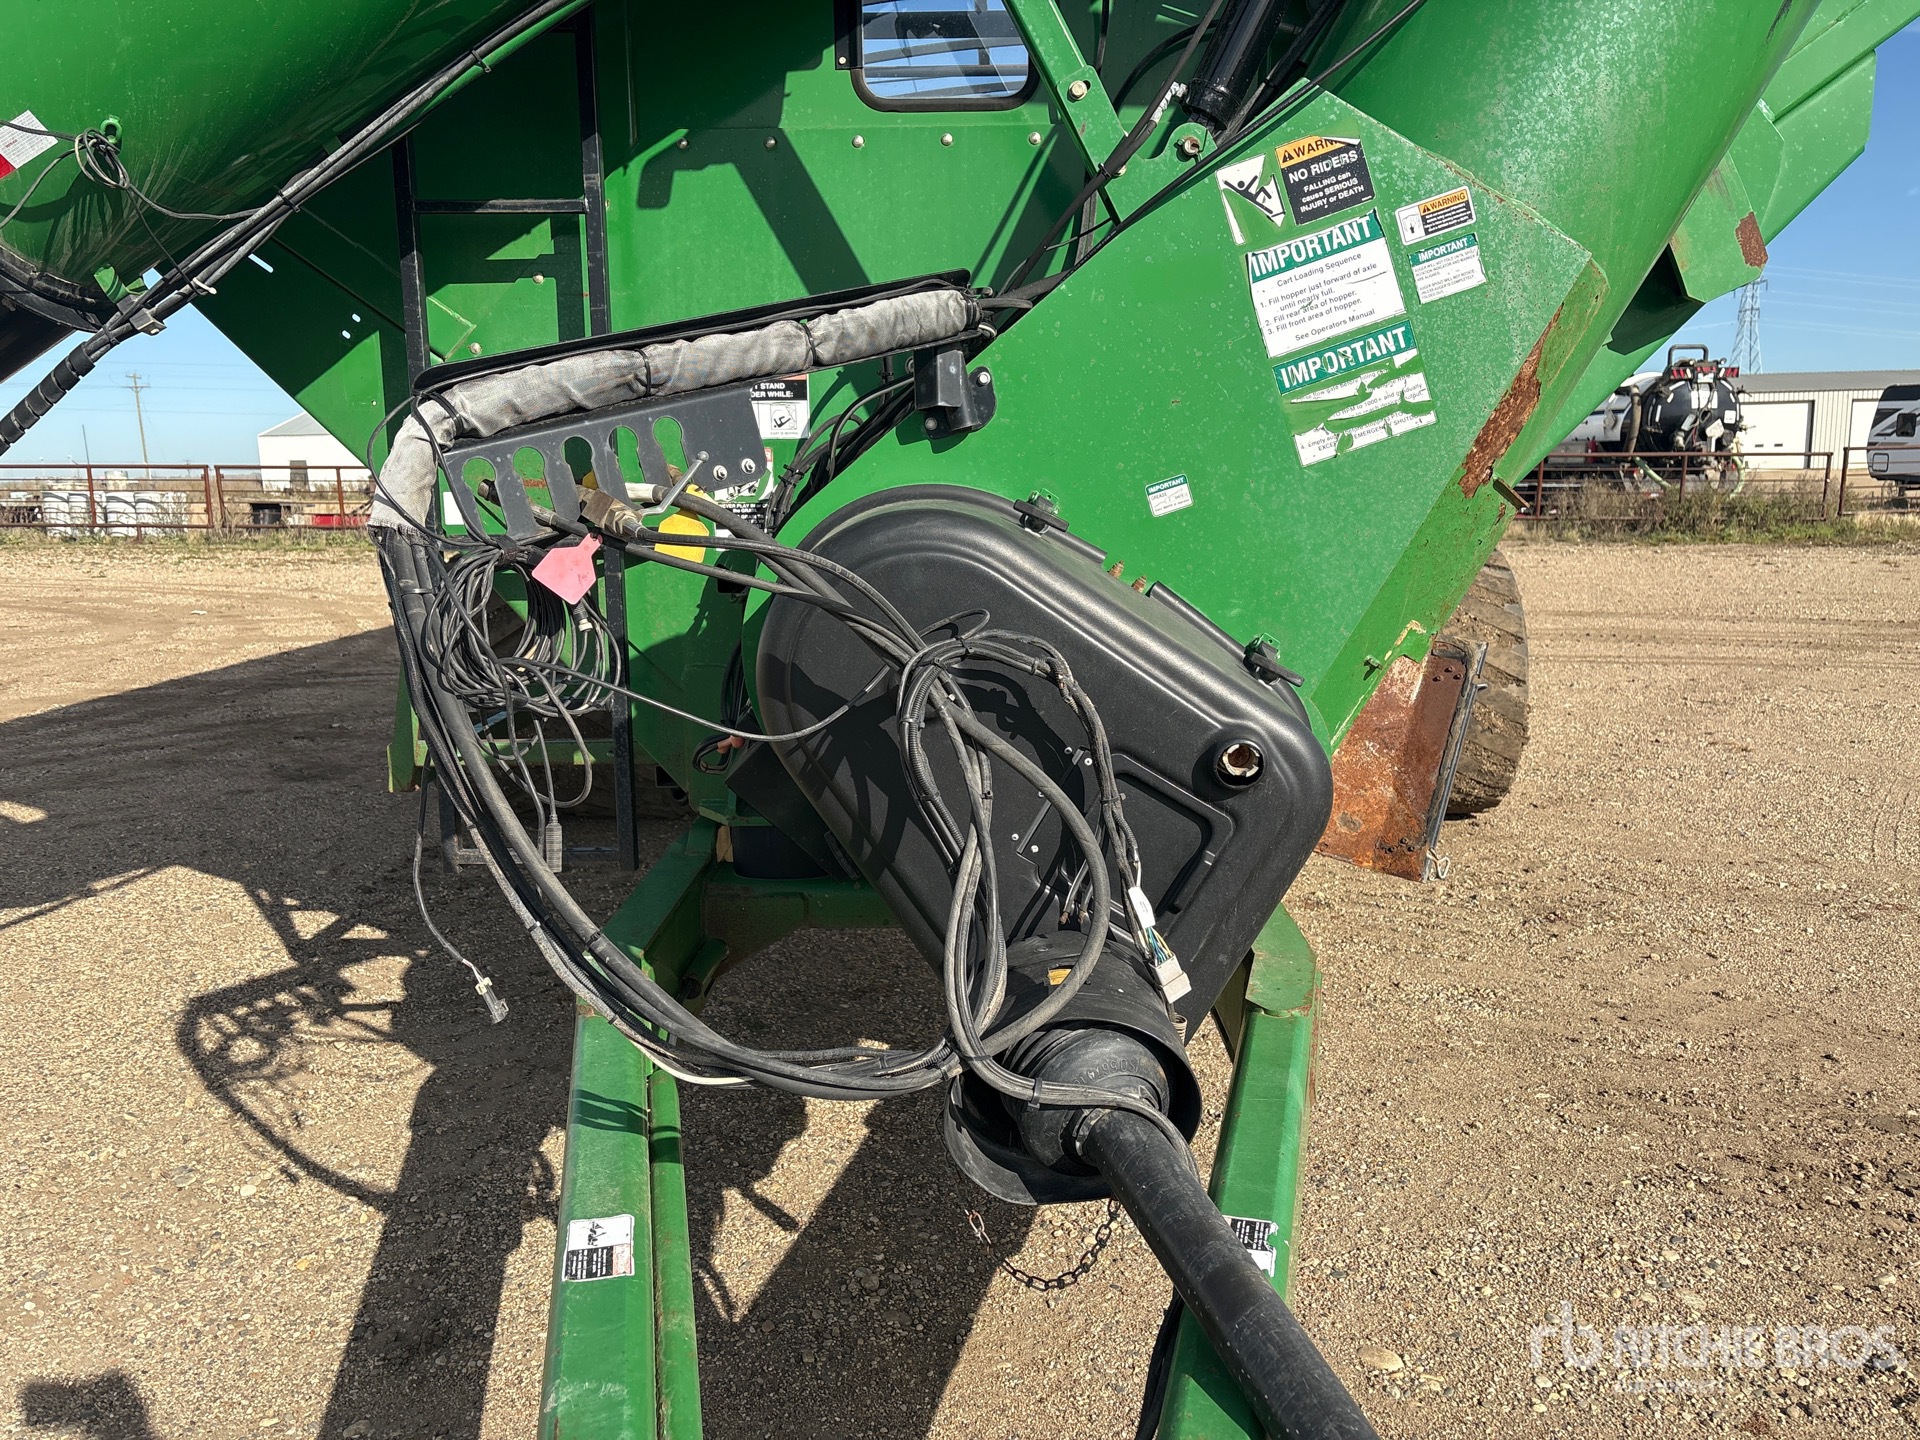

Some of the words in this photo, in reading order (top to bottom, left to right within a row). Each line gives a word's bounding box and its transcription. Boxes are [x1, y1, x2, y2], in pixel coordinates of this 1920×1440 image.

[1293, 139, 1338, 158] WARN
[1288, 168, 1308, 183] NO
[1310, 150, 1358, 176] RIDERS
[1301, 191, 1324, 203] cause
[1324, 177, 1358, 195] SERIOUS
[1303, 176, 1336, 193] FALLING
[1337, 172, 1351, 181] can
[1300, 197, 1327, 213] INJURY
[1328, 195, 1337, 203] or
[1337, 185, 1365, 200] DEATH
[1430, 192, 1466, 211] WARNING
[1251, 216, 1371, 277] IMPORTANT
[1418, 238, 1468, 262] IMPORTANT
[1268, 297, 1280, 306] Fill
[1281, 288, 1307, 304] hopper
[1308, 282, 1322, 293] just
[1323, 273, 1351, 288] forward
[1353, 267, 1362, 277] of
[1362, 262, 1377, 273] axle
[1277, 276, 1293, 287] Cart
[1294, 266, 1324, 280] Loading
[1325, 253, 1362, 270] Sequence
[1273, 314, 1285, 323] Fill
[1286, 309, 1301, 318] rear
[1302, 305, 1319, 313] area
[1320, 298, 1329, 307] of
[1329, 290, 1357, 305] hopper.
[1280, 301, 1296, 311] until
[1297, 294, 1320, 308] nearly
[1321, 287, 1336, 297] full.
[1276, 322, 1287, 332] Fill
[1288, 317, 1306, 329] front
[1307, 312, 1324, 322] area
[1325, 306, 1333, 315] of
[1333, 298, 1362, 314] hopper.
[1295, 332, 1309, 341] See
[1311, 319, 1347, 337] Operators
[1349, 308, 1375, 323] Manual
[1280, 326, 1406, 388] IMPORTANT
[760, 382, 786, 390] STAND
[1148, 477, 1185, 493] IMPORTANT
